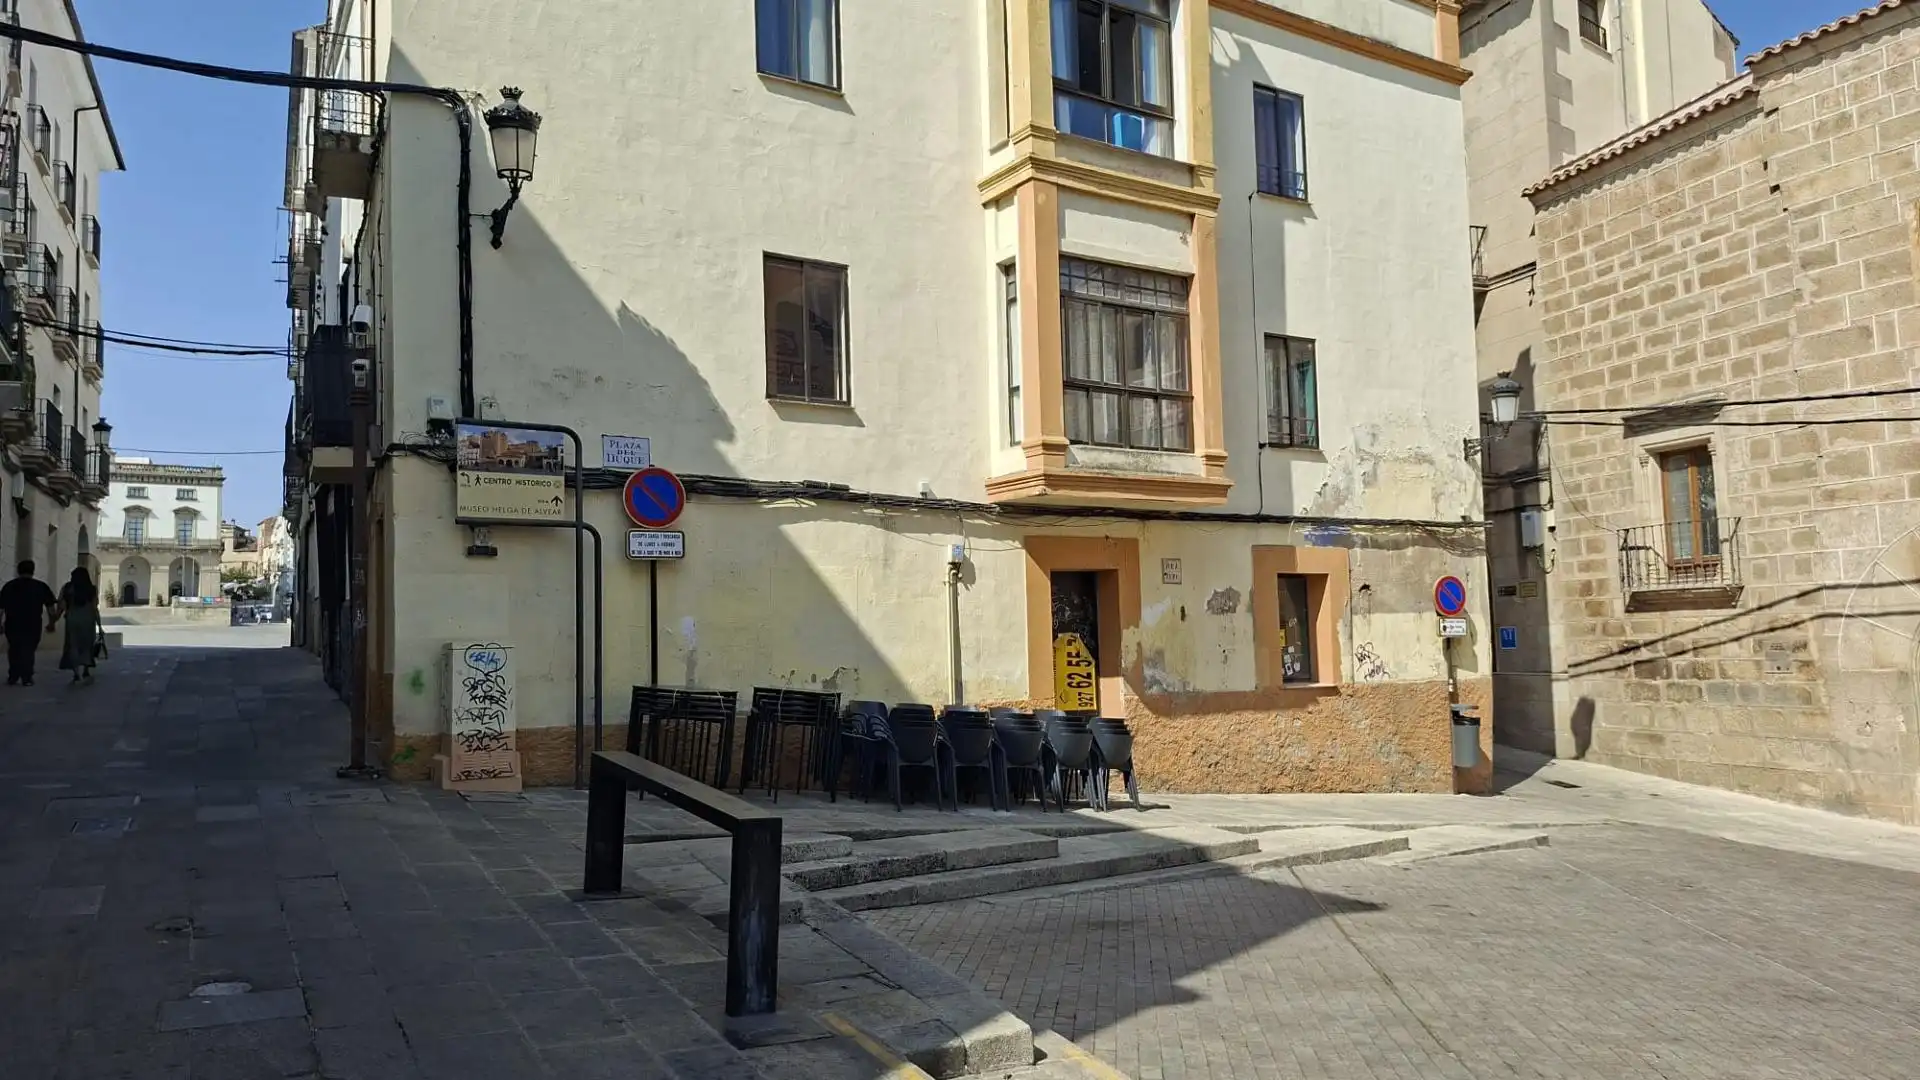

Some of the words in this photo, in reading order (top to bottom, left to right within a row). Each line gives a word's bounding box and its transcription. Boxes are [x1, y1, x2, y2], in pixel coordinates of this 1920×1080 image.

[608, 440, 641, 449] PLAZA
[607, 453, 645, 464] DUQUE
[484, 477, 512, 485] CENTRO
[460, 505, 489, 513] MUSEO
[492, 506, 519, 514] HELGA
[534, 508, 562, 516] ALVEAR
[1067, 671, 1093, 689] 62
[1078, 691, 1094, 708] 927
